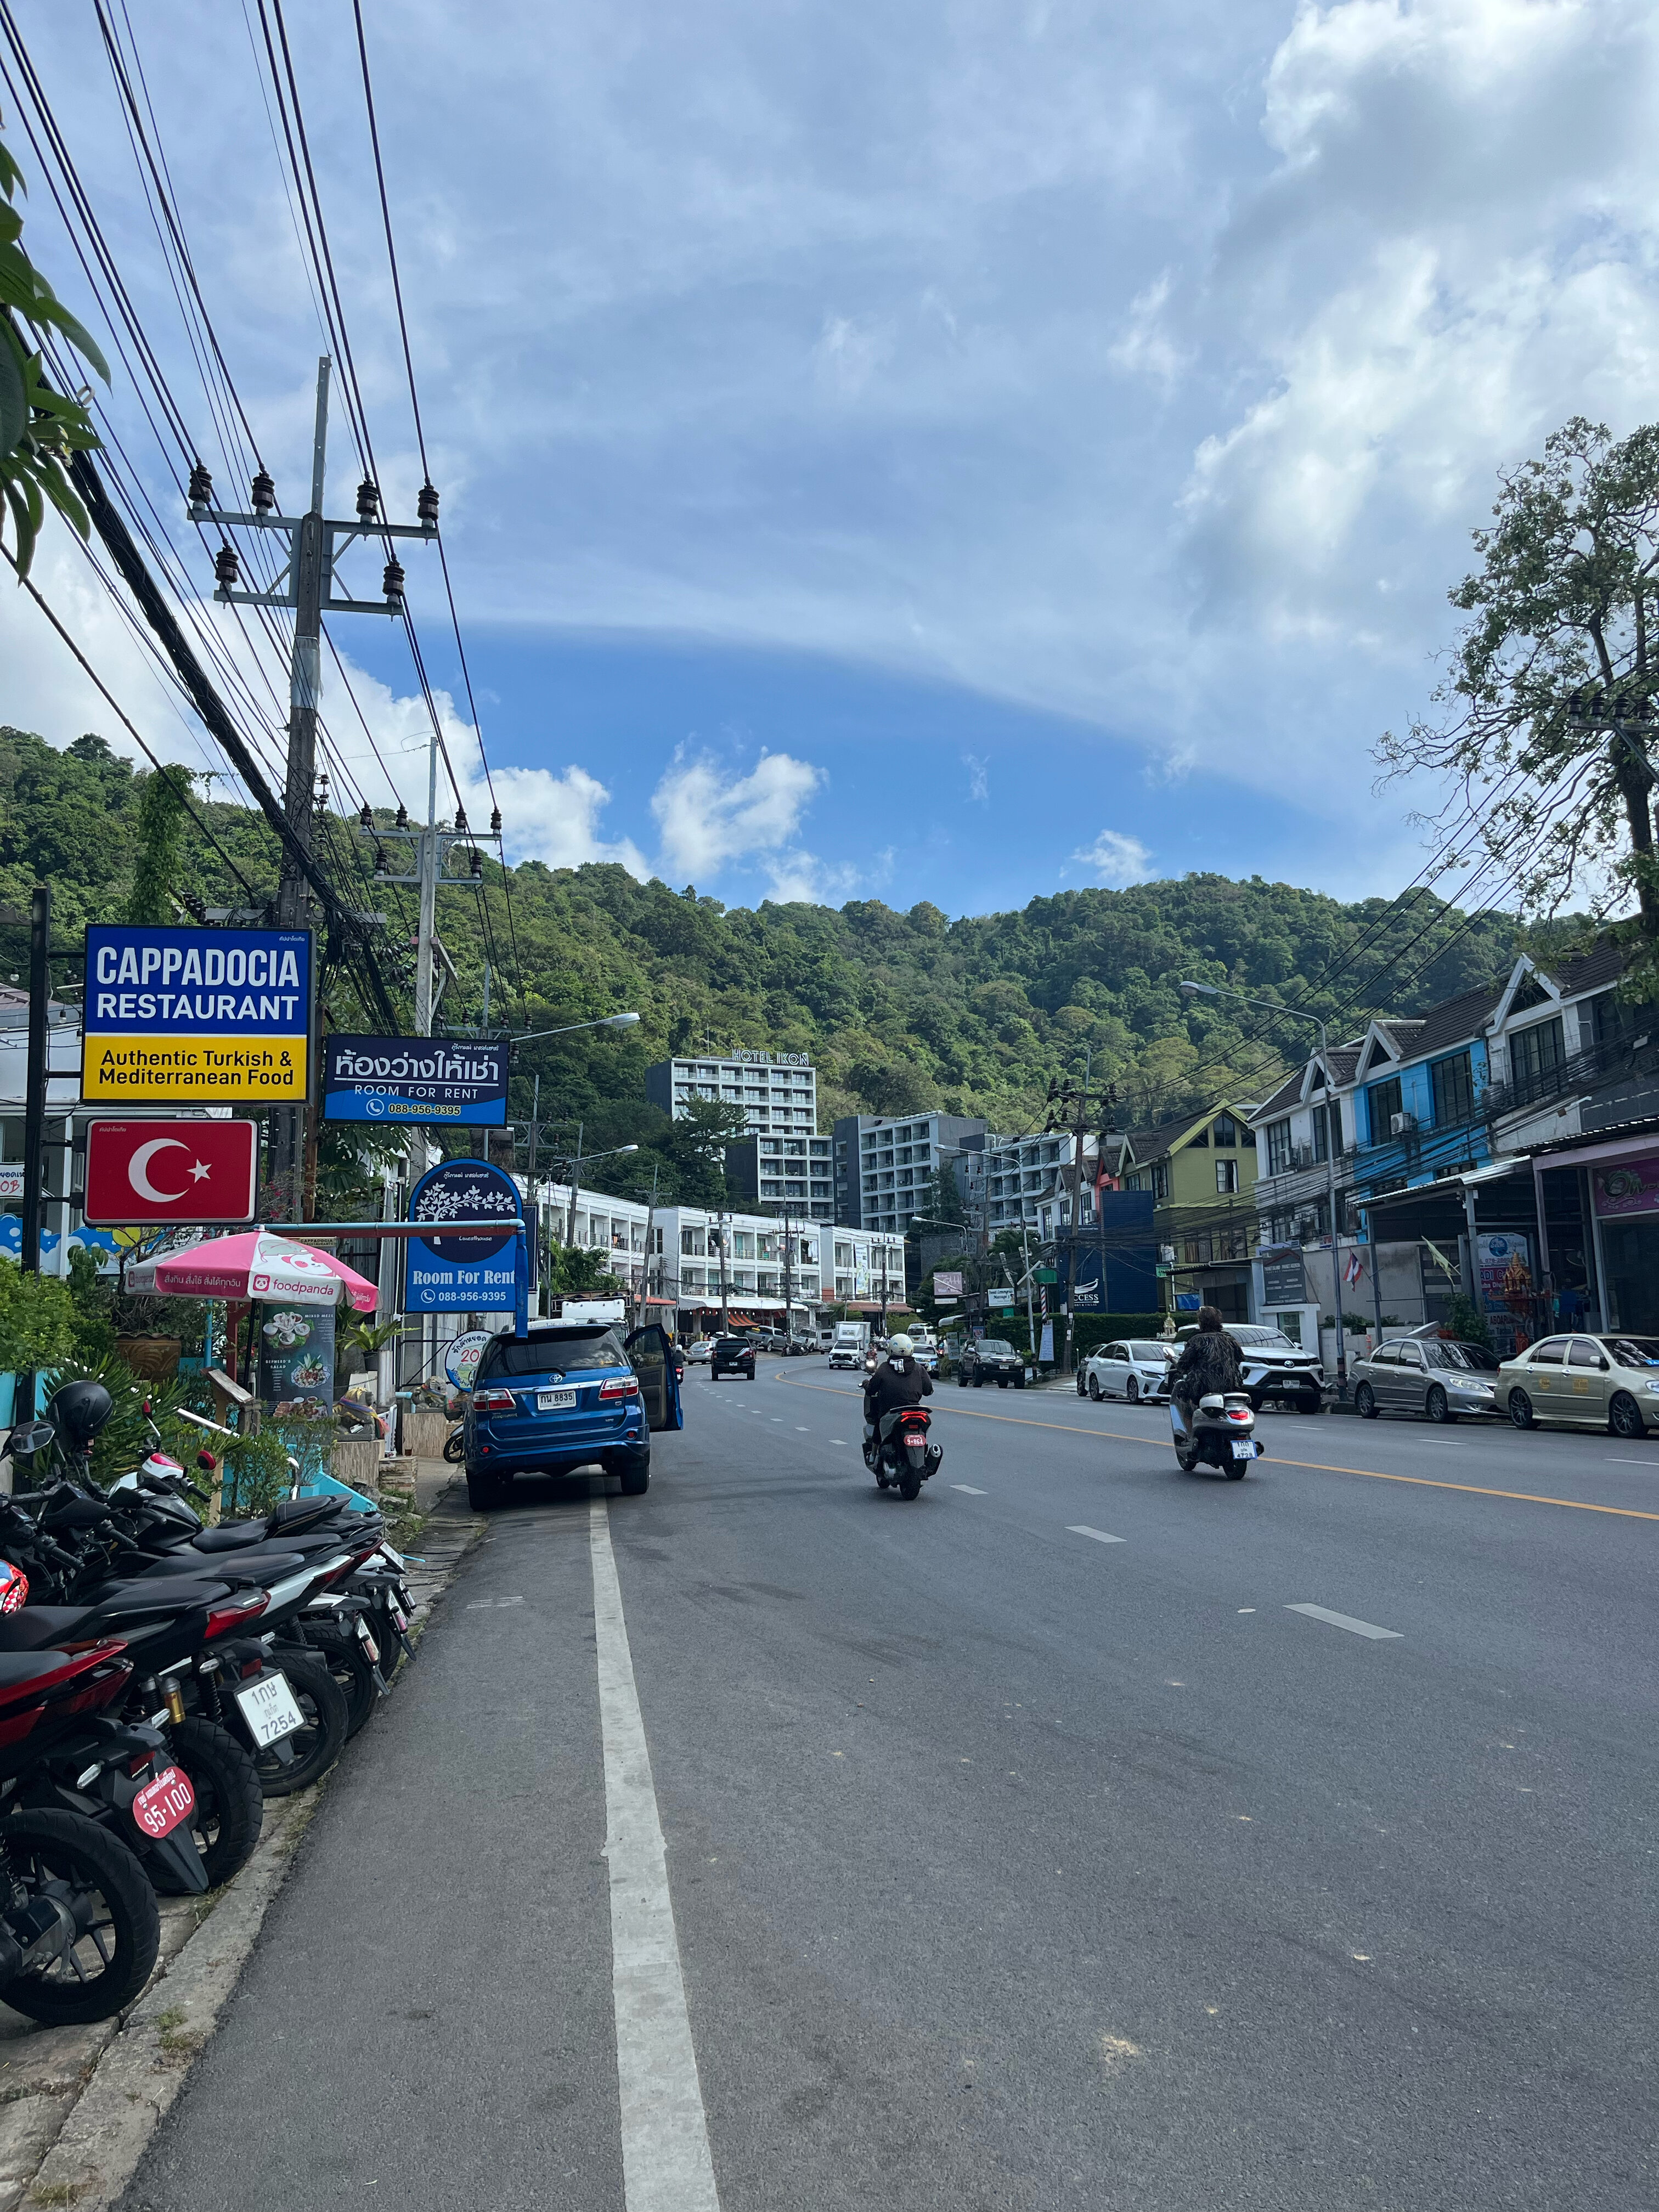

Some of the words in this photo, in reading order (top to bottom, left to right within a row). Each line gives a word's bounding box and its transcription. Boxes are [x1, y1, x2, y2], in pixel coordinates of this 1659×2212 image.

[97, 946, 300, 988] CAPPADOCIA
[97, 994, 299, 1020] RESTAURANT
[101, 1049, 198, 1066] Authentic
[203, 1050, 273, 1067] Turkish
[279, 1051, 292, 1068] &
[335, 1049, 499, 1081] ห้องว่างให้เช่า
[732, 1048, 774, 1064] HOTEL
[776, 1052, 809, 1066] IKON
[99, 1068, 242, 1085] Mediterranean
[247, 1069, 294, 1086] Food
[354, 1084, 399, 1097] ROOM
[408, 1086, 437, 1098] FOR
[444, 1088, 478, 1099] RENT
[388, 1103, 461, 1116] 088-956-9395
[413, 1269, 454, 1285] Room
[456, 1269, 481, 1285] For
[483, 1269, 515, 1284] Rent
[273, 1279, 335, 1296] foodpanda
[438, 1291, 506, 1302] 088-956-9395
[461, 1349, 479, 1363] 20
[554, 1392, 573, 1402] 8835
[261, 1711, 296, 1740] 7254
[144, 1782, 191, 1833] 95-100
